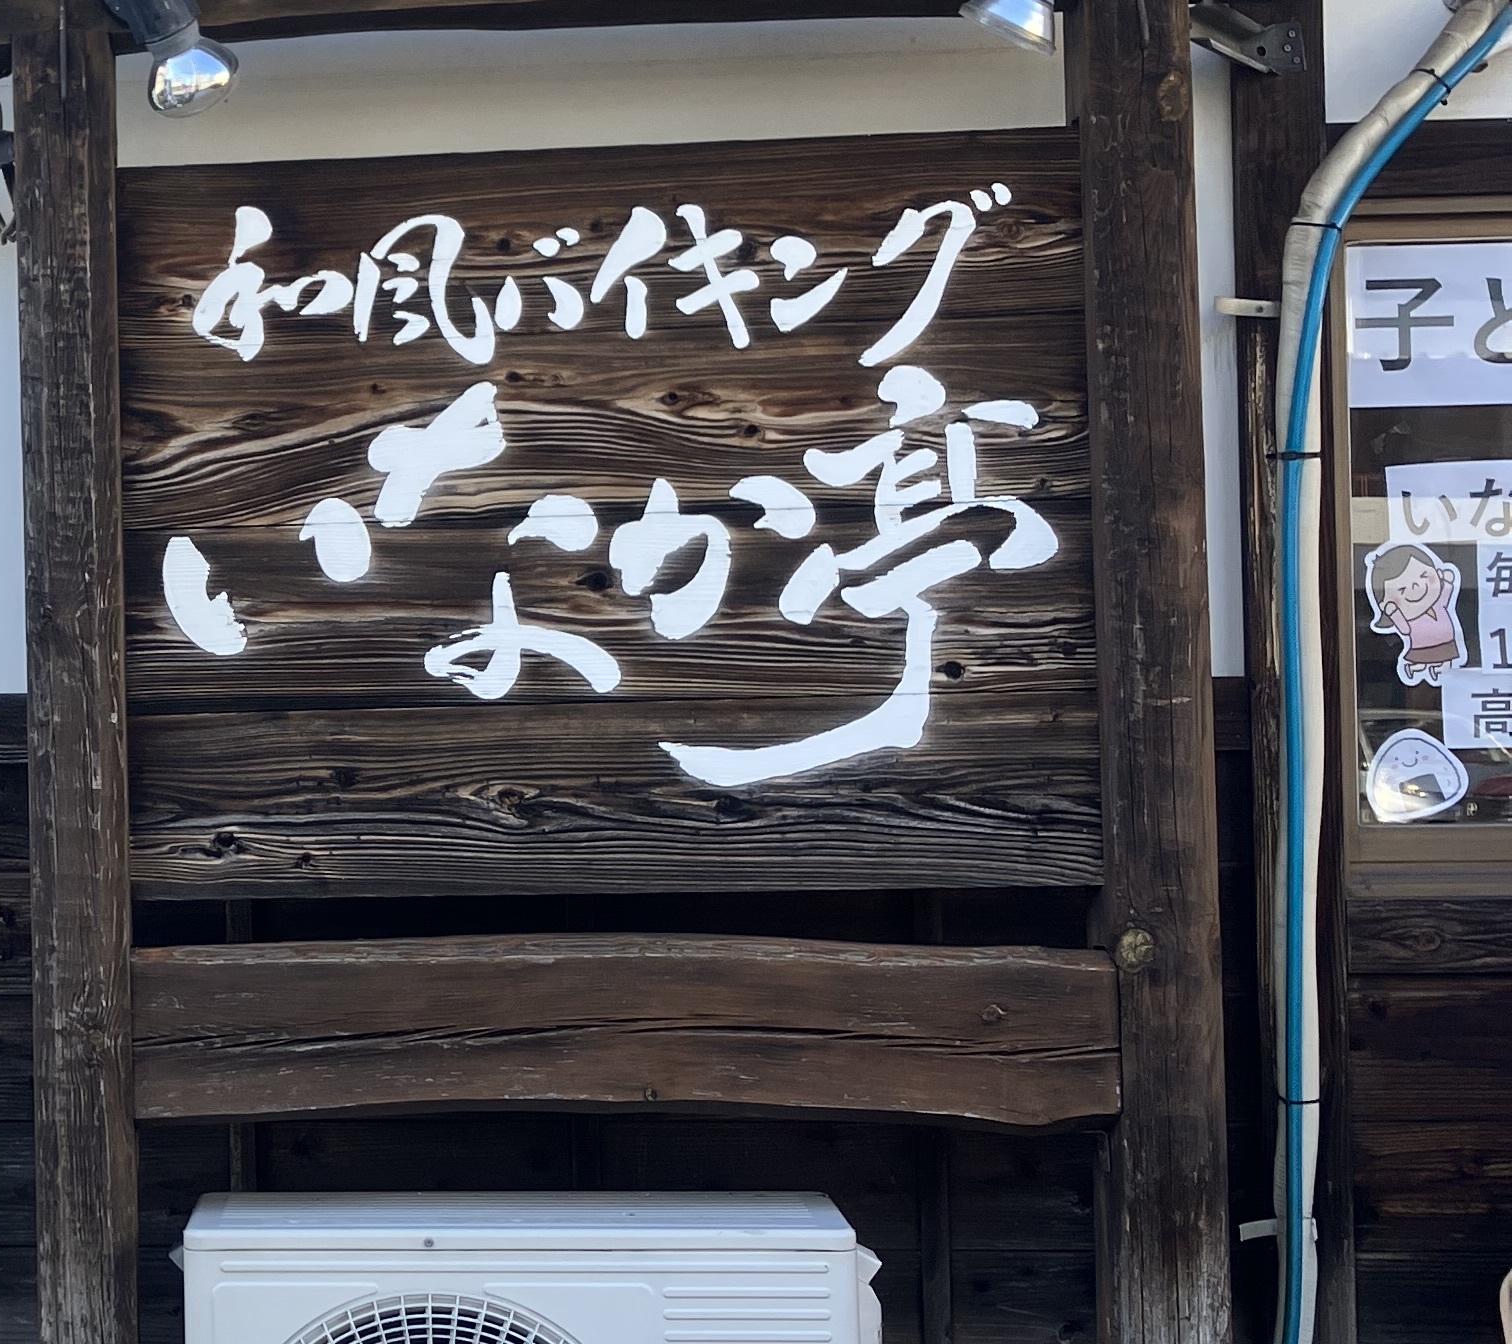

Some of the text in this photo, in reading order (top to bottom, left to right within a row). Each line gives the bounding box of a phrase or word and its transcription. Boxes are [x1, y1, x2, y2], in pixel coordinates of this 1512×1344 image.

[191, 181, 1013, 366] 和風バイキング
